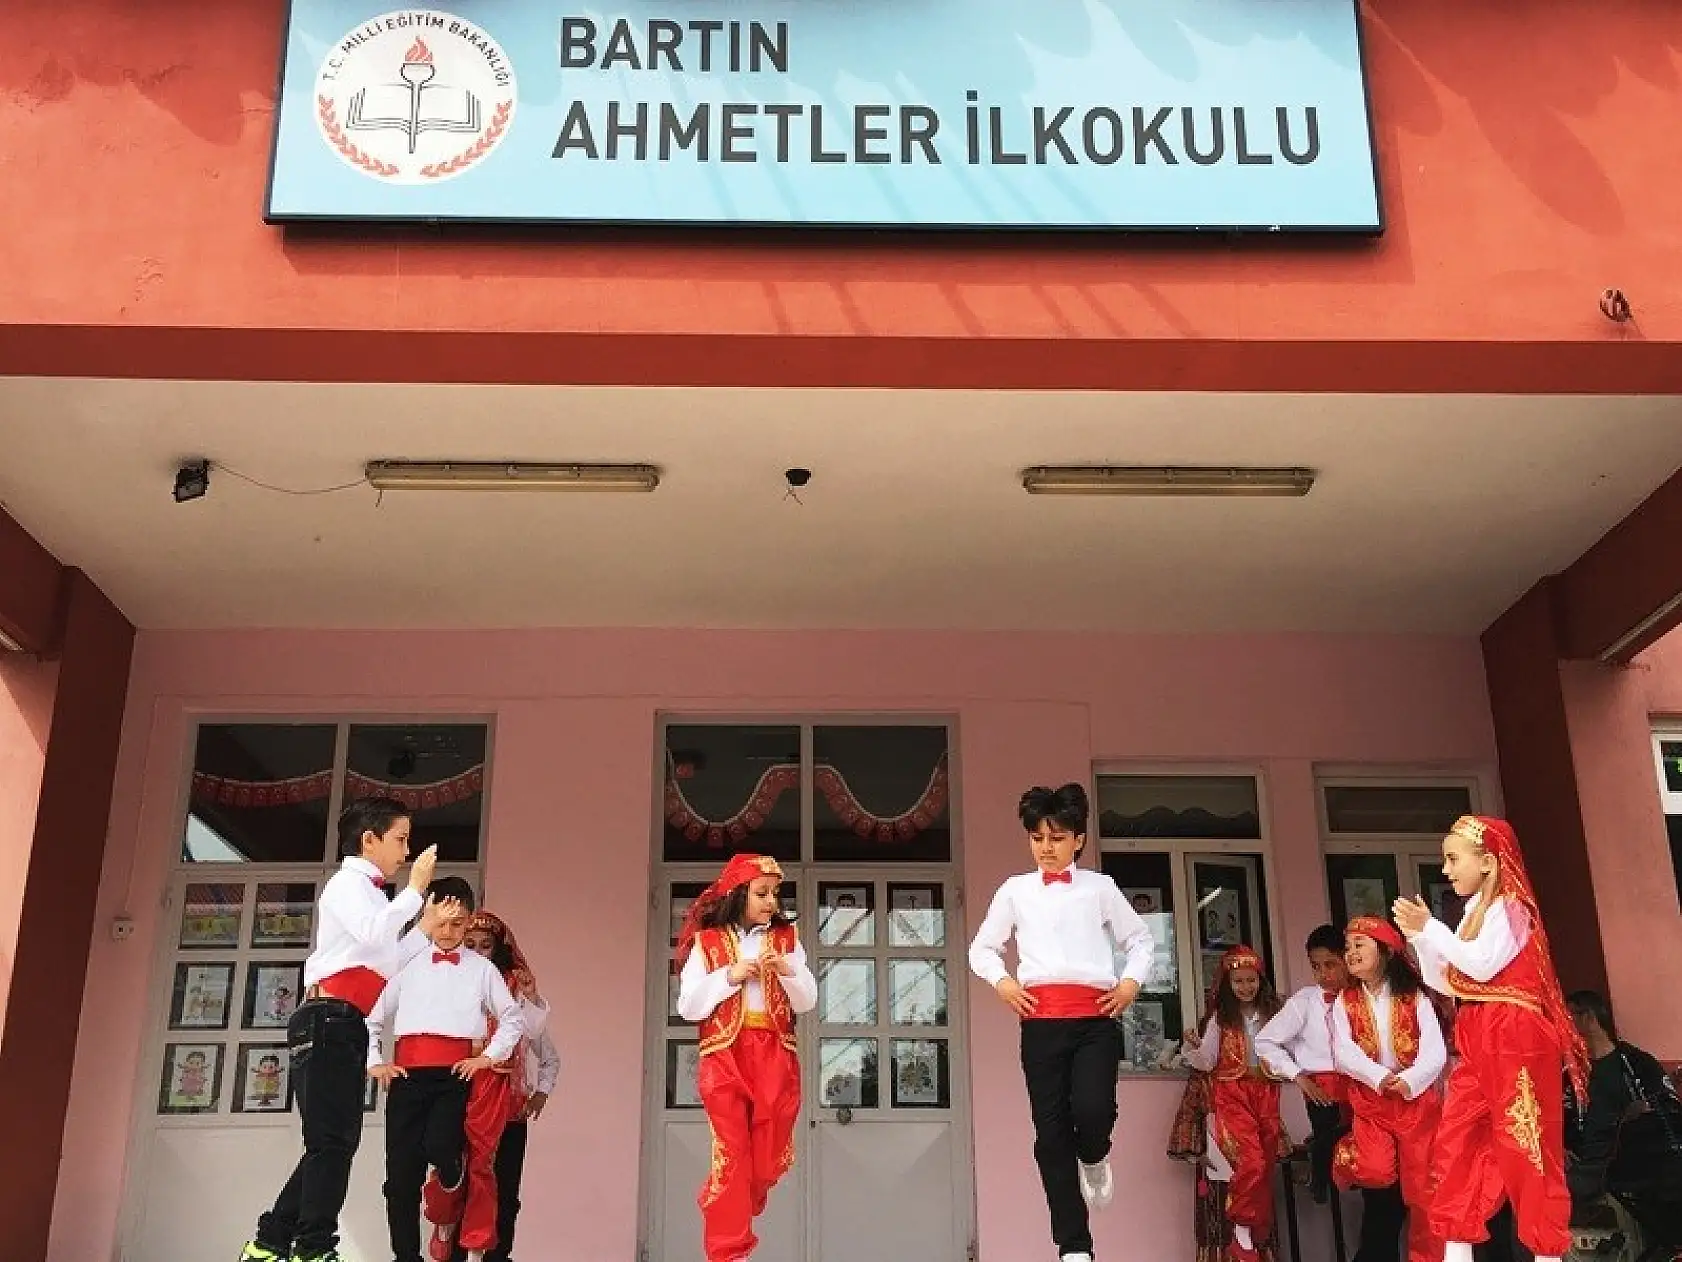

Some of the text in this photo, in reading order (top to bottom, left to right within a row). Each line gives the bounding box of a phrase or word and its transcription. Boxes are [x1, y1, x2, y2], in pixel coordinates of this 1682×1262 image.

[385, 11, 445, 30] EĞİTİM
[448, 20, 510, 87] BAKANLIĞI
[560, 16, 789, 73] BARTIN
[551, 90, 1321, 165] AHMETLER İLKOKULU
